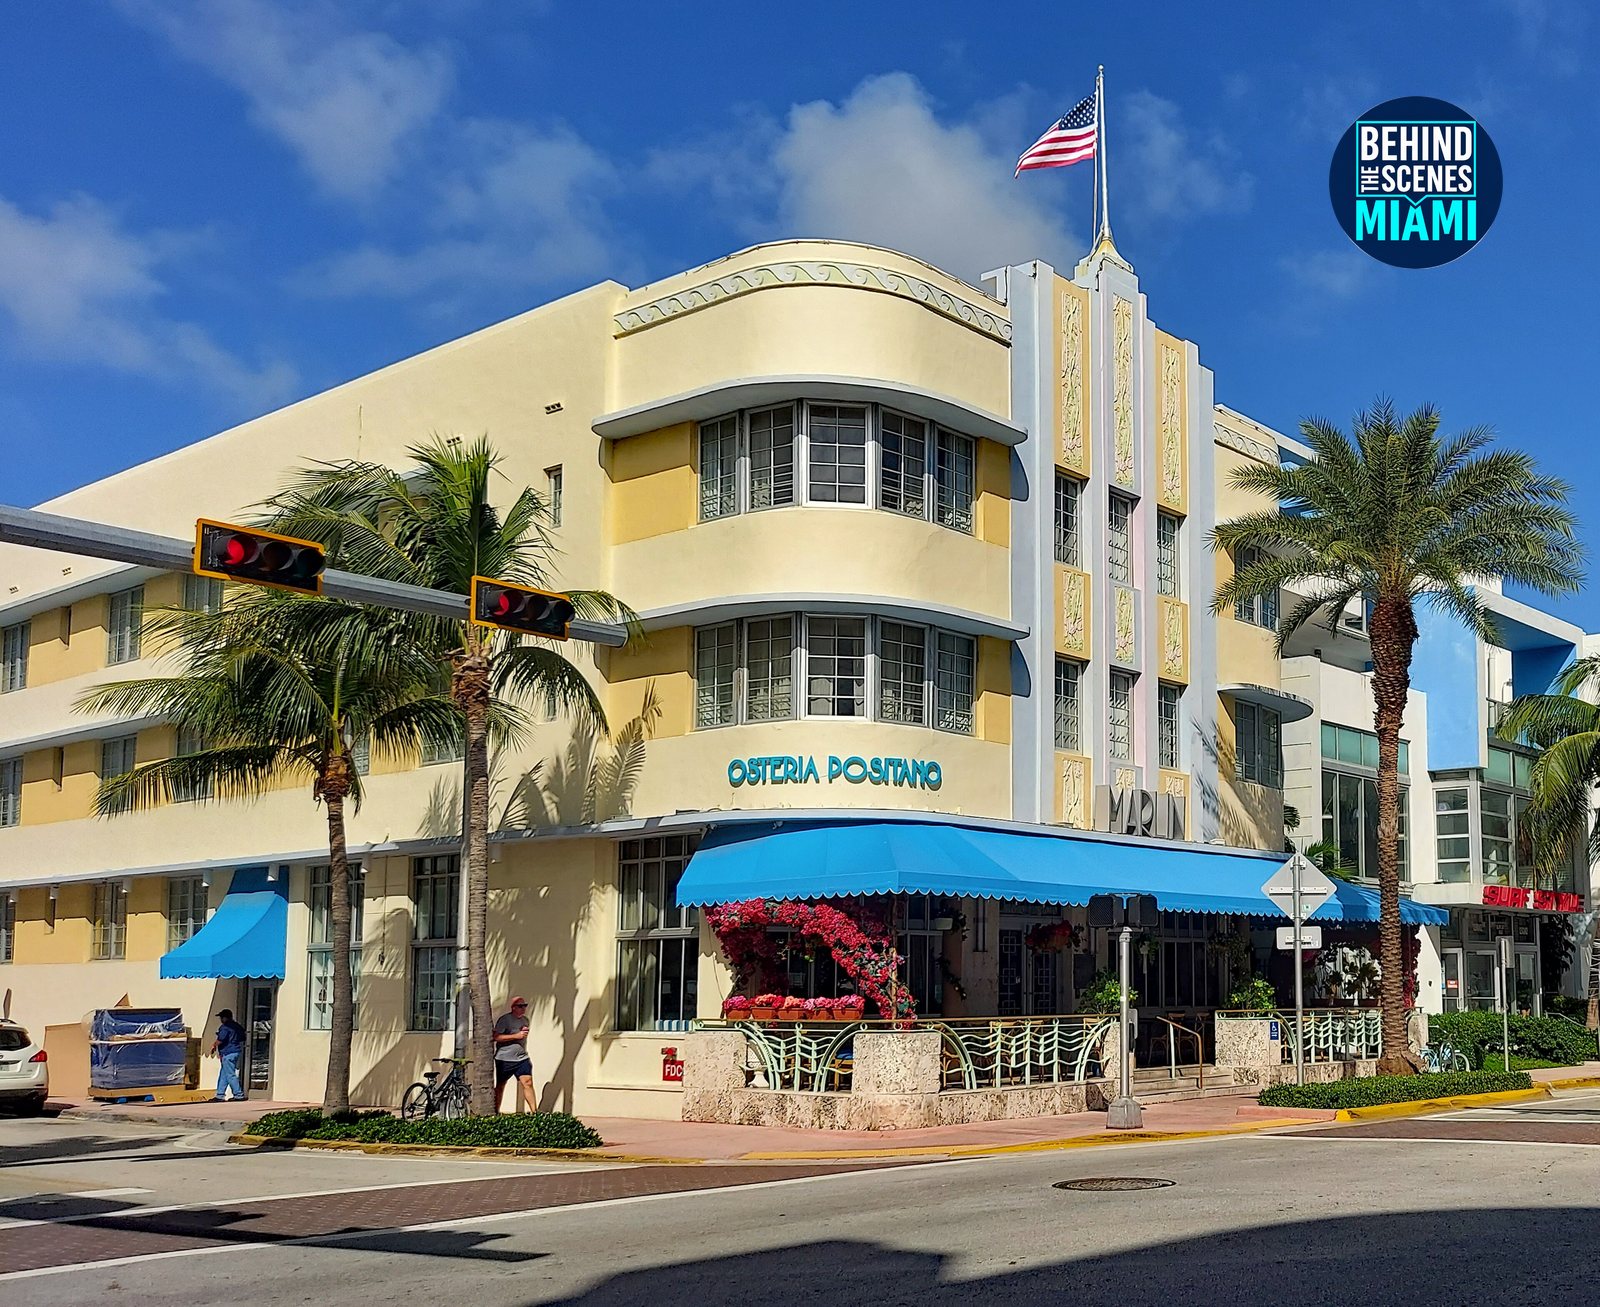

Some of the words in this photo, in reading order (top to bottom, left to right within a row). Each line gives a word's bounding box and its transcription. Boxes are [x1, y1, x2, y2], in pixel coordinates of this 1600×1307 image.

[728, 755, 819, 788] OSTERIA
[828, 755, 943, 791] POSITANO
[1482, 885, 1531, 908] SURF
[665, 1064, 683, 1077] FDC
